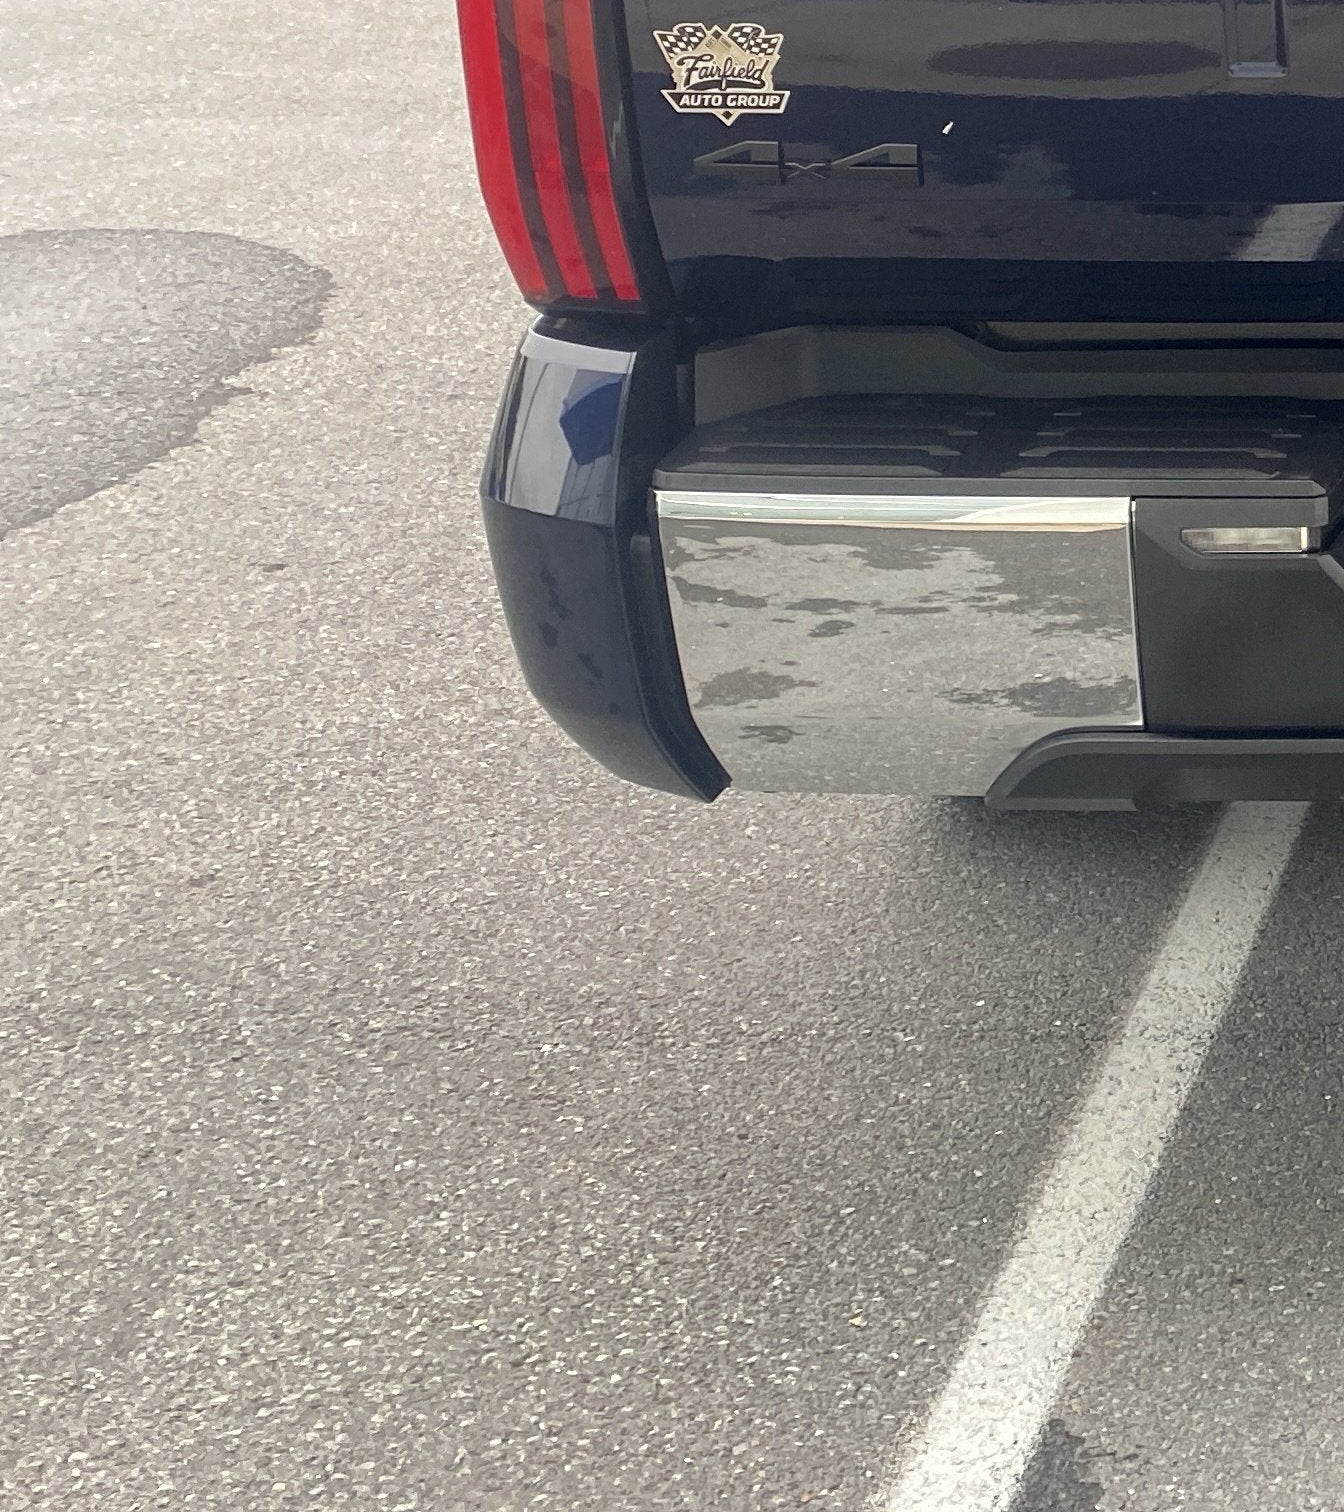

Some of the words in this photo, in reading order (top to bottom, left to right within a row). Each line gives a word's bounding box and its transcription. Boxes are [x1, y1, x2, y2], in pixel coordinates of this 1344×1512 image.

[676, 53, 770, 88] Fairfield
[680, 94, 721, 107] AUTO
[726, 94, 781, 107] GROUP
